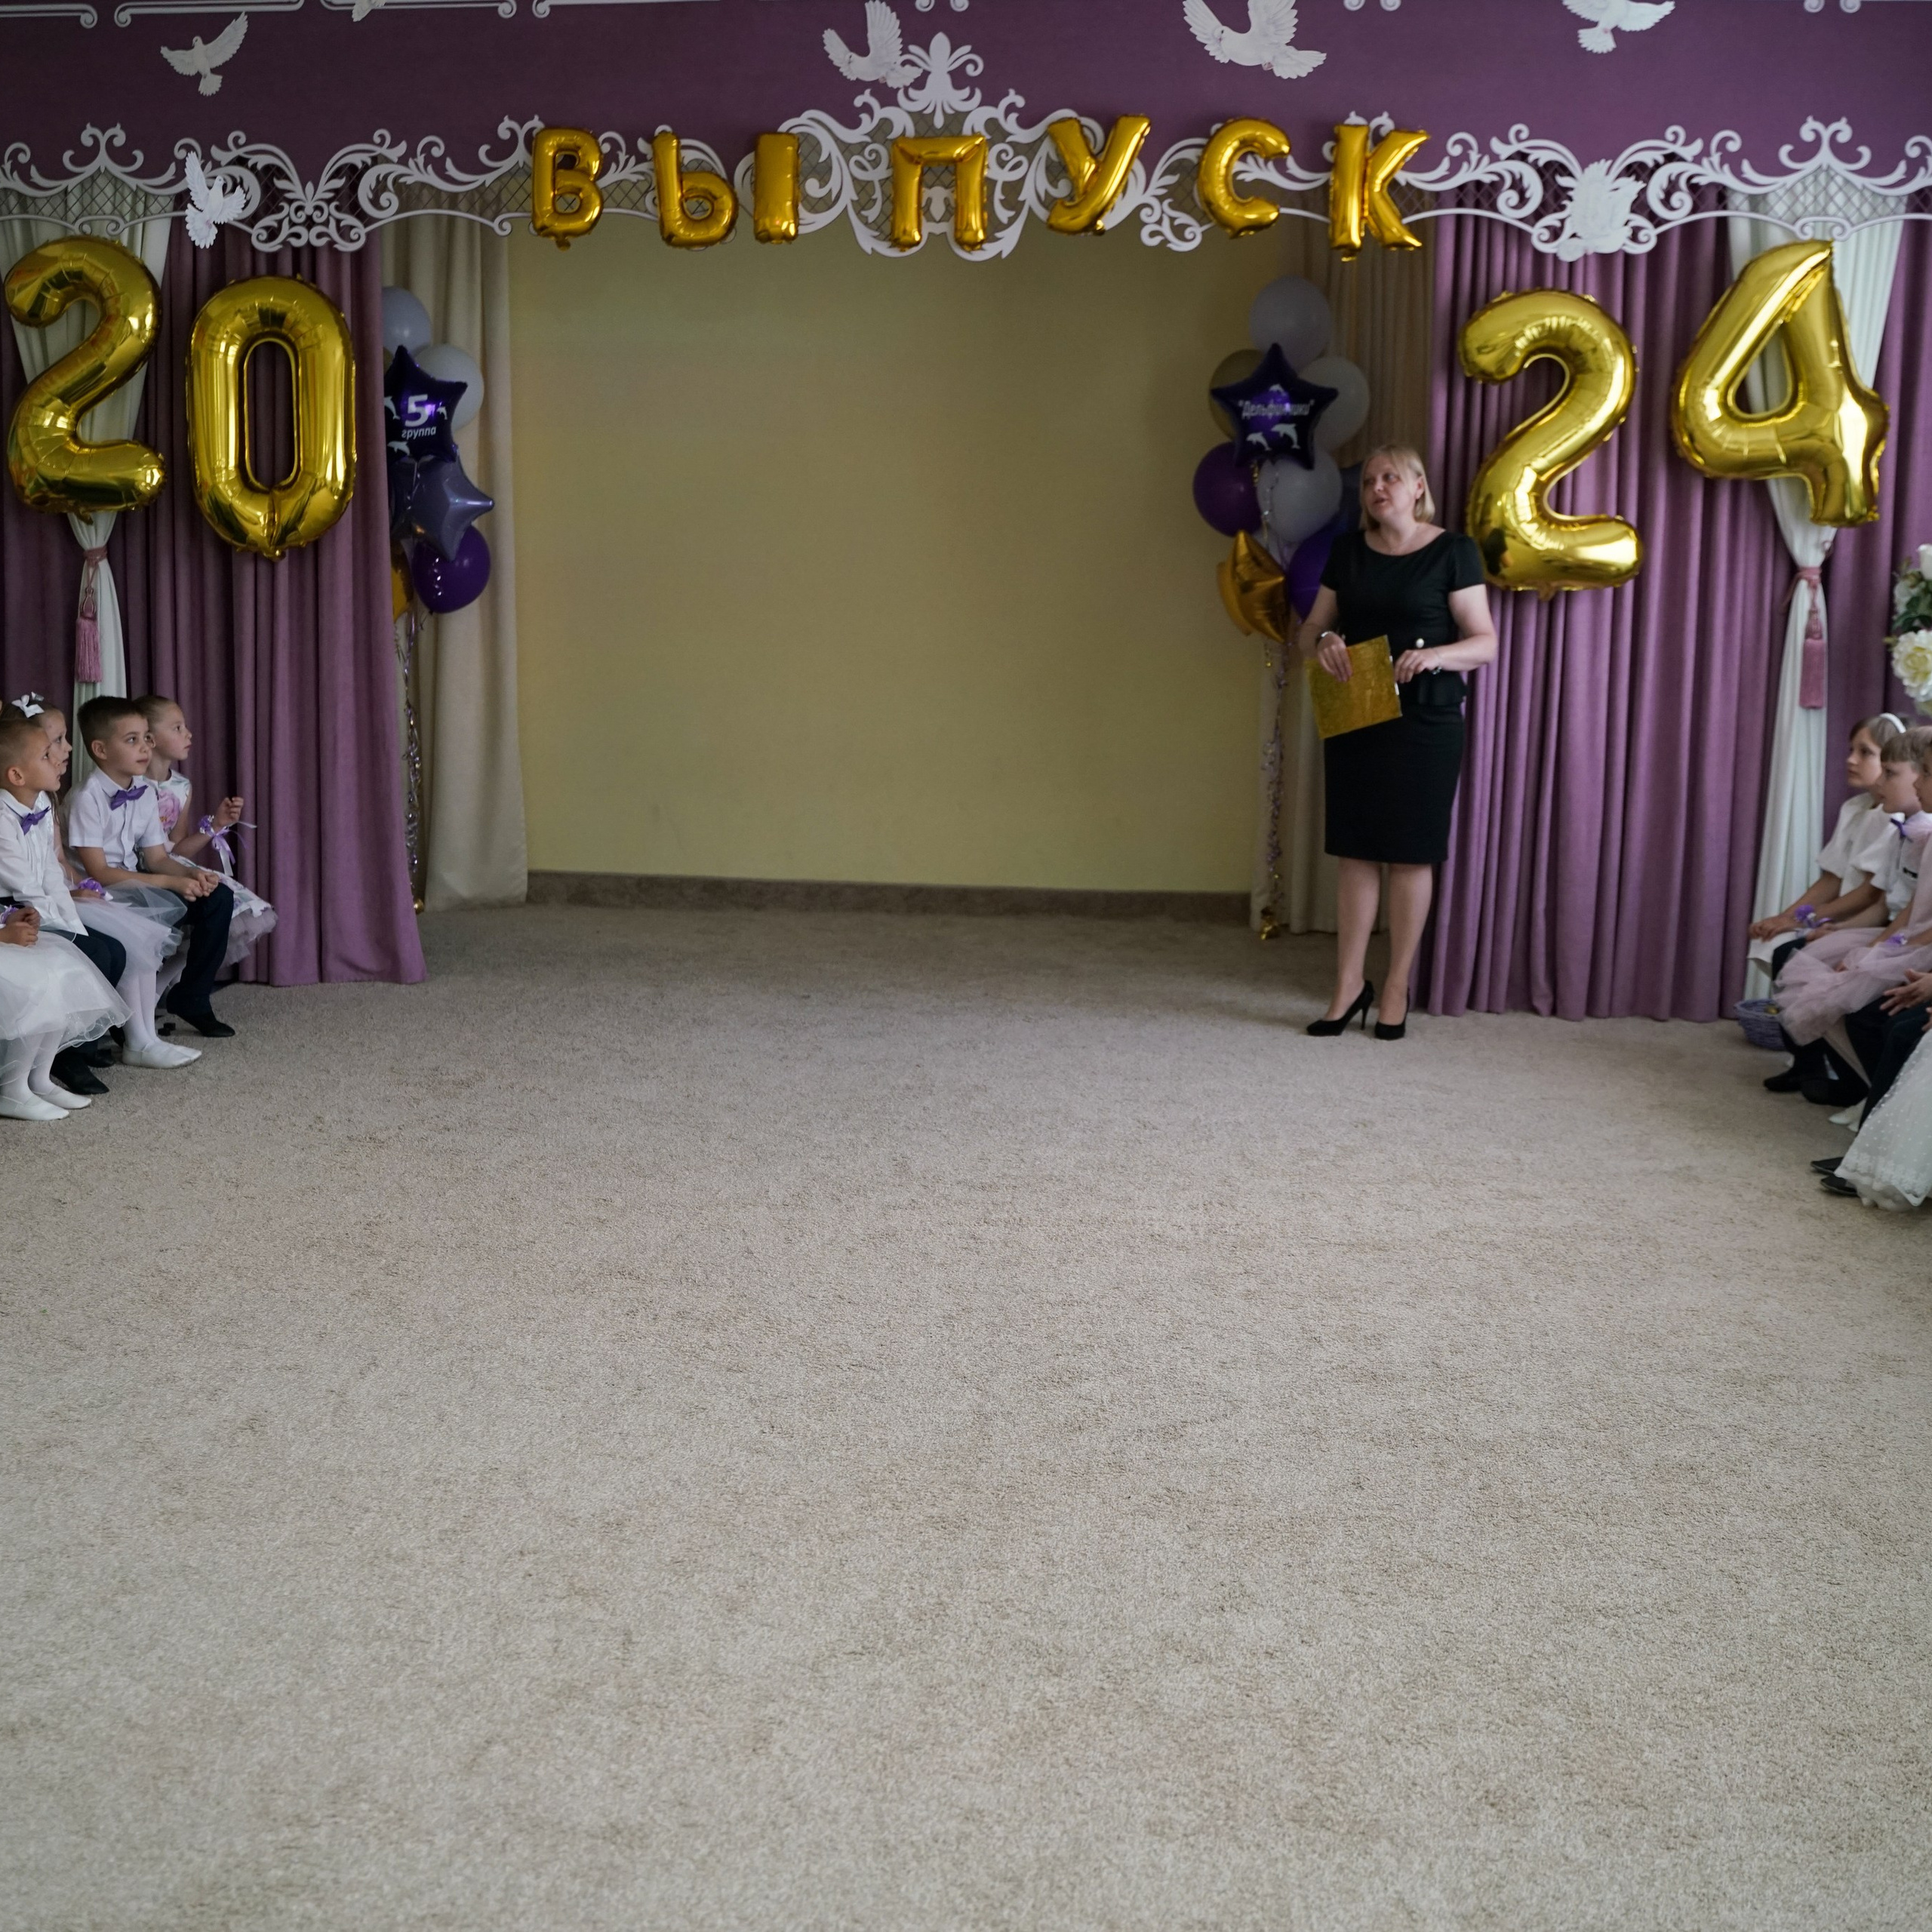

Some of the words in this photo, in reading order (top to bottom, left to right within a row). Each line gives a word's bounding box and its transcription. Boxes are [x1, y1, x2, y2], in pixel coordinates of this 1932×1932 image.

[531, 114, 1431, 258] ВЫПУСК
[2, 235, 358, 561] 20
[401, 426, 436, 439] группа
[405, 394, 429, 426] 5
[1458, 240, 1890, 595] 24
